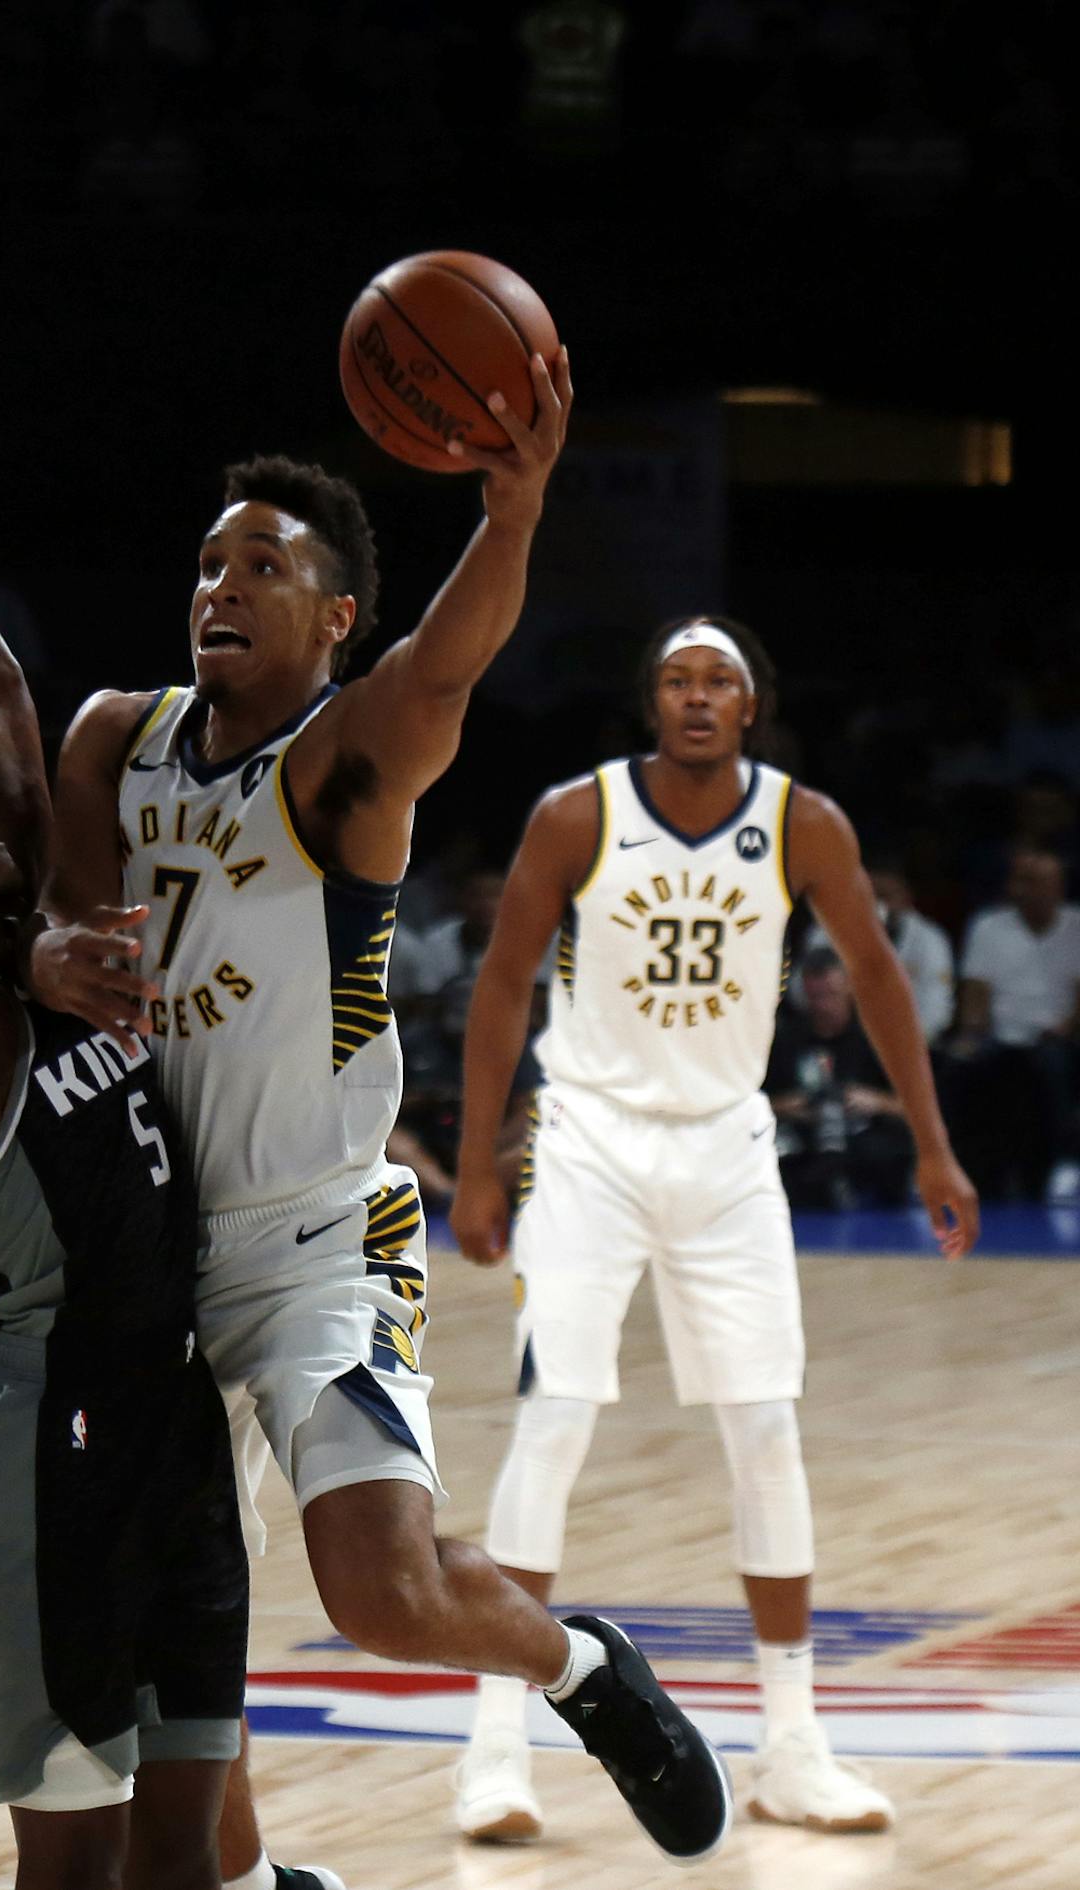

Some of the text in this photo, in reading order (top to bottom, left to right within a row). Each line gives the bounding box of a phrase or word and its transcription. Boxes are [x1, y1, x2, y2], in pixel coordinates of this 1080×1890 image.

[153, 864, 201, 970] 7
[610, 869, 761, 935] INDIANA
[646, 917, 725, 987] 33
[148, 960, 255, 1039] CERS
[622, 975, 743, 1029] PACERS
[127, 1089, 171, 1188] 5
